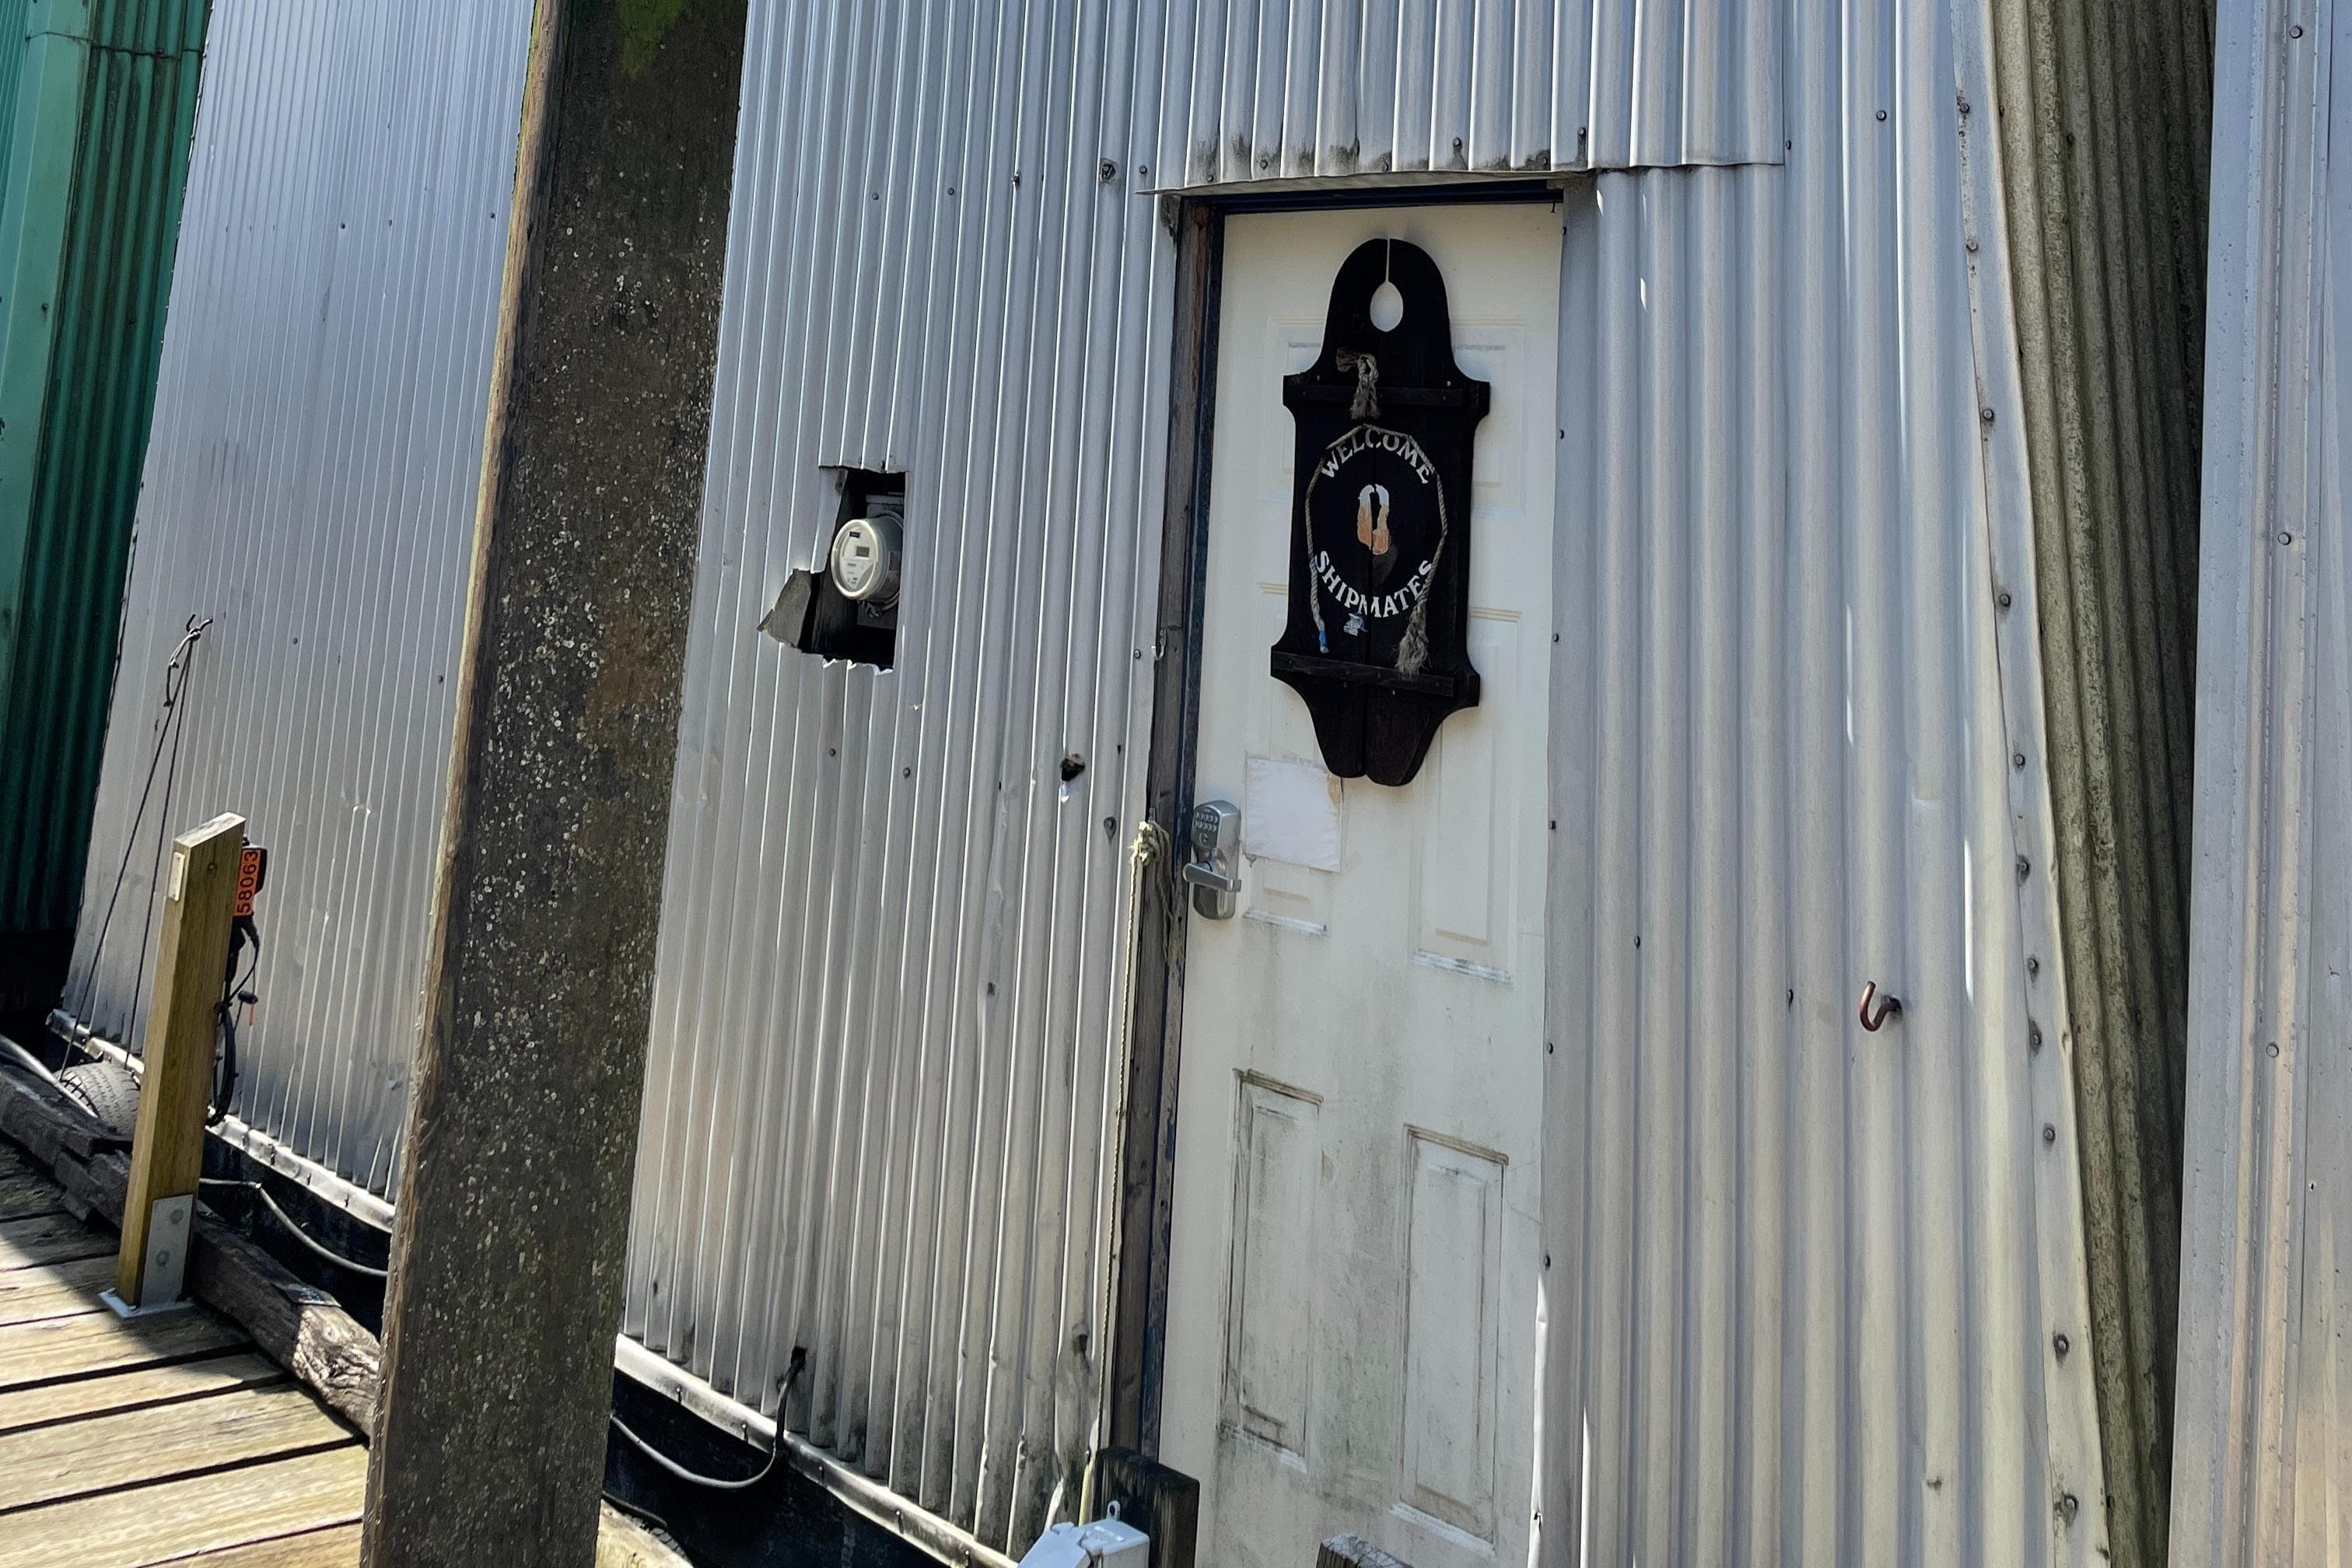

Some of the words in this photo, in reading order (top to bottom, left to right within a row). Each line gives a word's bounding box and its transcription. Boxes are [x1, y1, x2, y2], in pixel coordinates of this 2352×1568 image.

[1321, 429, 1430, 484] WELCOME
[1314, 550, 1433, 618] SHIPMATES
[236, 851, 258, 913] 58063
